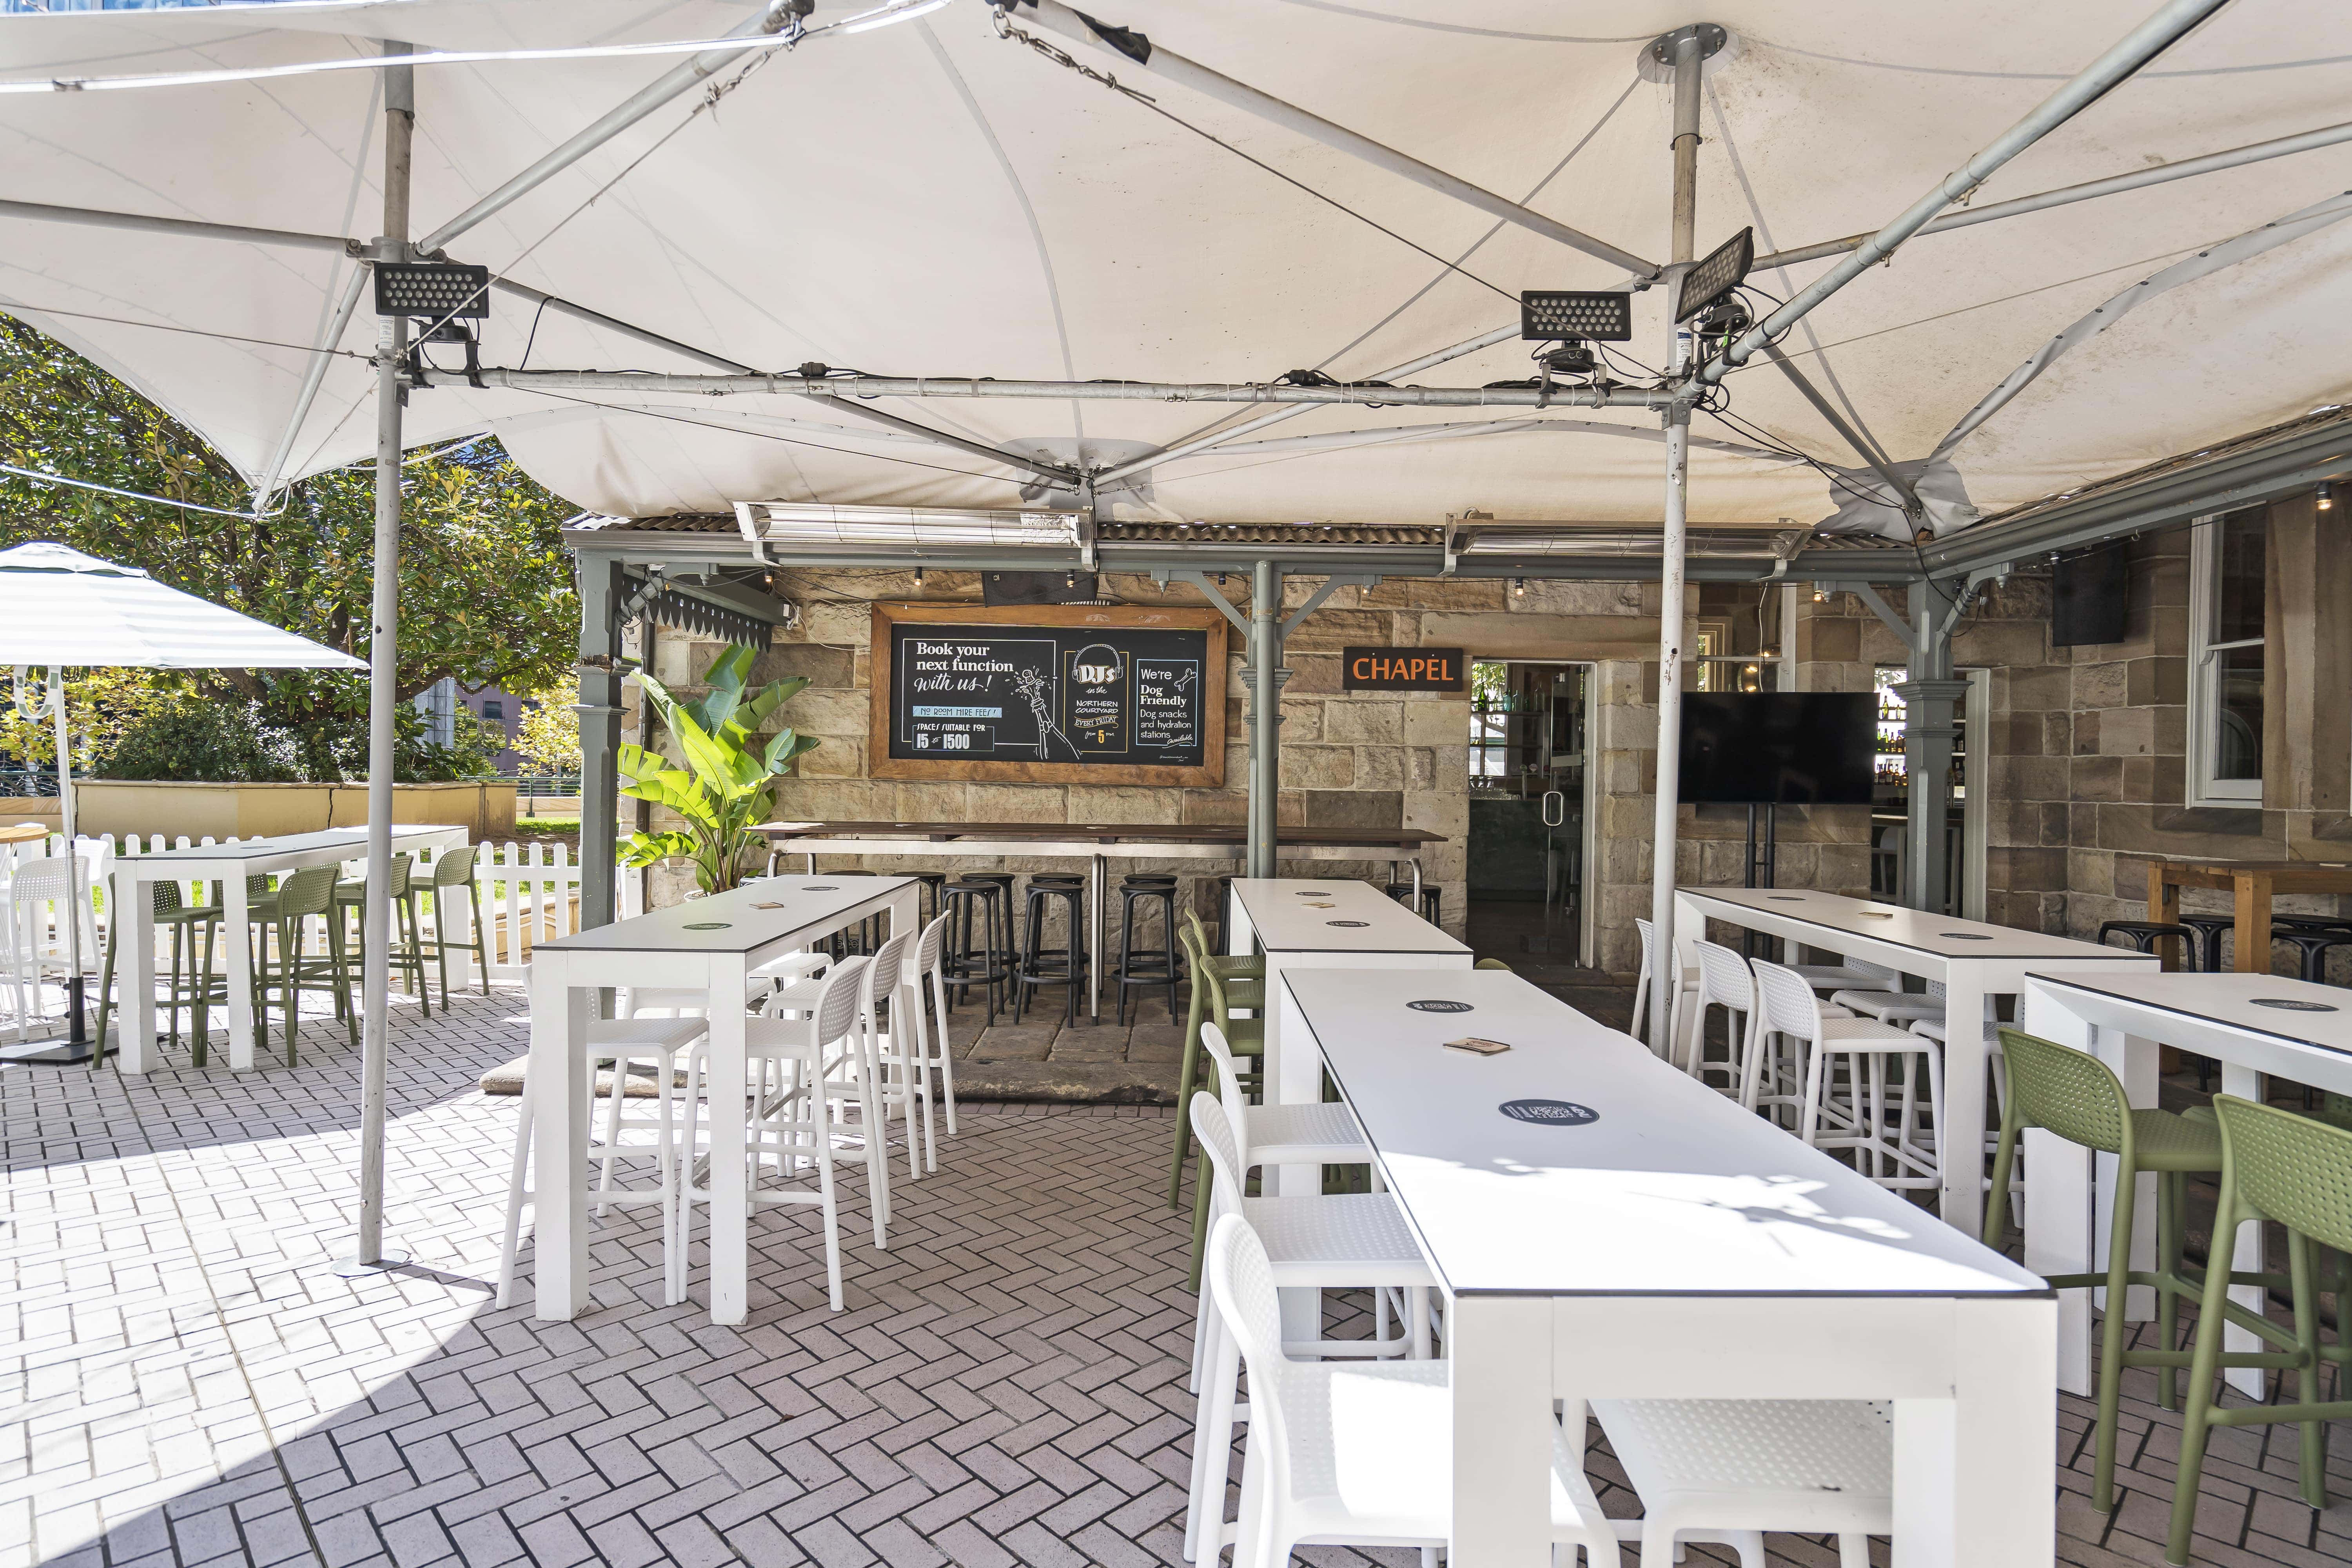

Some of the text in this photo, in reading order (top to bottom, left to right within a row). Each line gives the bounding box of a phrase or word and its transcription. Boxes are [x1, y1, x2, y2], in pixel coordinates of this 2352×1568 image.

[916, 642, 990, 658] Book your
[916, 659, 1014, 672] next function
[1353, 658, 1454, 681] CHAPEL
[1078, 664, 1116, 684] DJs
[1141, 669, 1172, 680] We're
[914, 672, 992, 693] with us!
[1140, 685, 1163, 697] Dog
[1140, 695, 1187, 708] Friendly
[1140, 710, 1187, 719] Dog snacks
[1158, 720, 1191, 730] hydration
[916, 733, 929, 749] 15
[943, 733, 970, 750] 1500
[1085, 731, 1096, 739] from
[1098, 730, 1104, 743] 5
[1167, 734, 1193, 744] available
